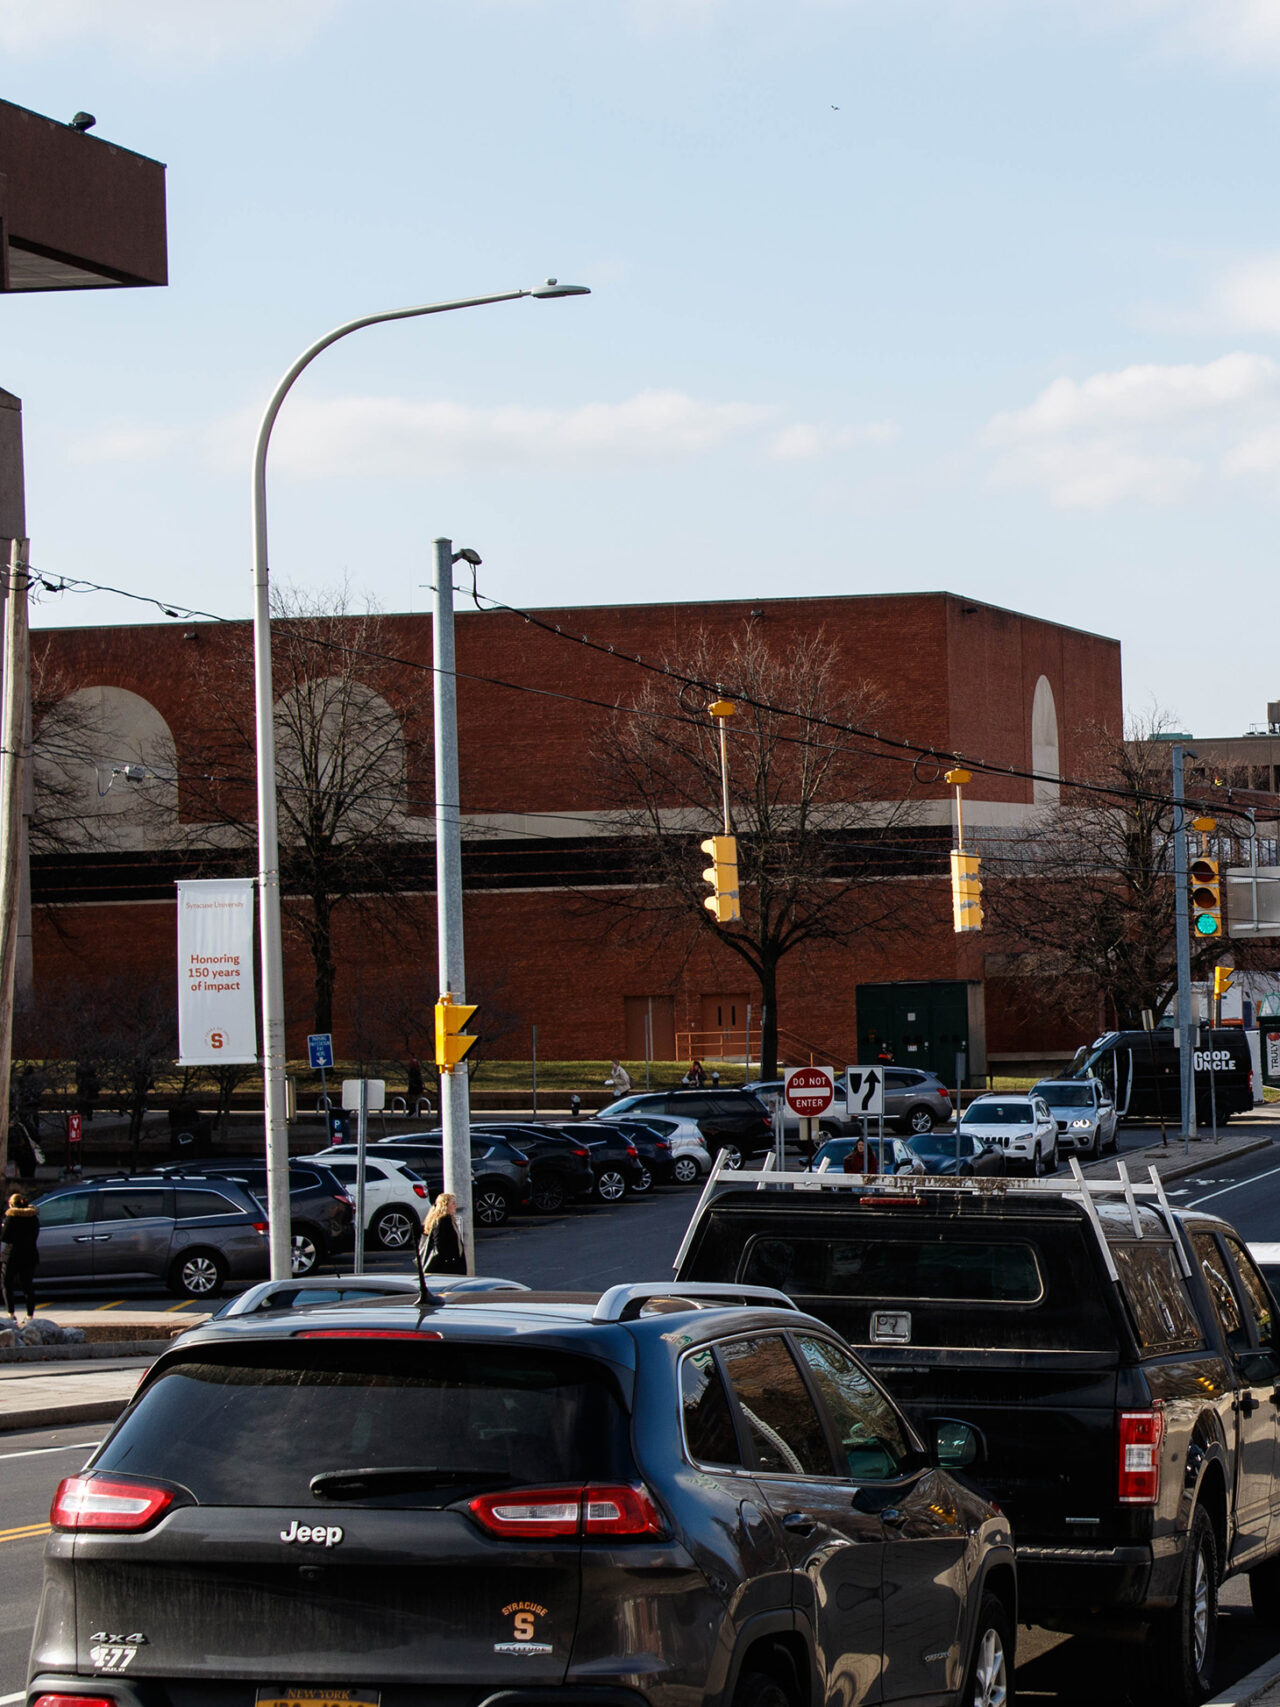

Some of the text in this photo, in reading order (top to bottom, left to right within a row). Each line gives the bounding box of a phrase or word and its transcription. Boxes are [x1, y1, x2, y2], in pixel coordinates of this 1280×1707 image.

[190, 954, 240, 966] Honoring
[188, 967, 241, 979] 150 years
[190, 981, 241, 993] of impact
[211, 1033, 223, 1049] S
[1193, 1050, 1230, 1062] GOOD
[1271, 1042, 1279, 1070] TRULY
[793, 1077, 826, 1086] DO NOT
[796, 1099, 823, 1108] ENTER
[280, 1520, 343, 1547] Jeep
[501, 1601, 548, 1616] SYRACUSE
[513, 1611, 534, 1640] S
[89, 1631, 146, 1644] 4x4
[288, 1688, 350, 1700] NEW YORK
